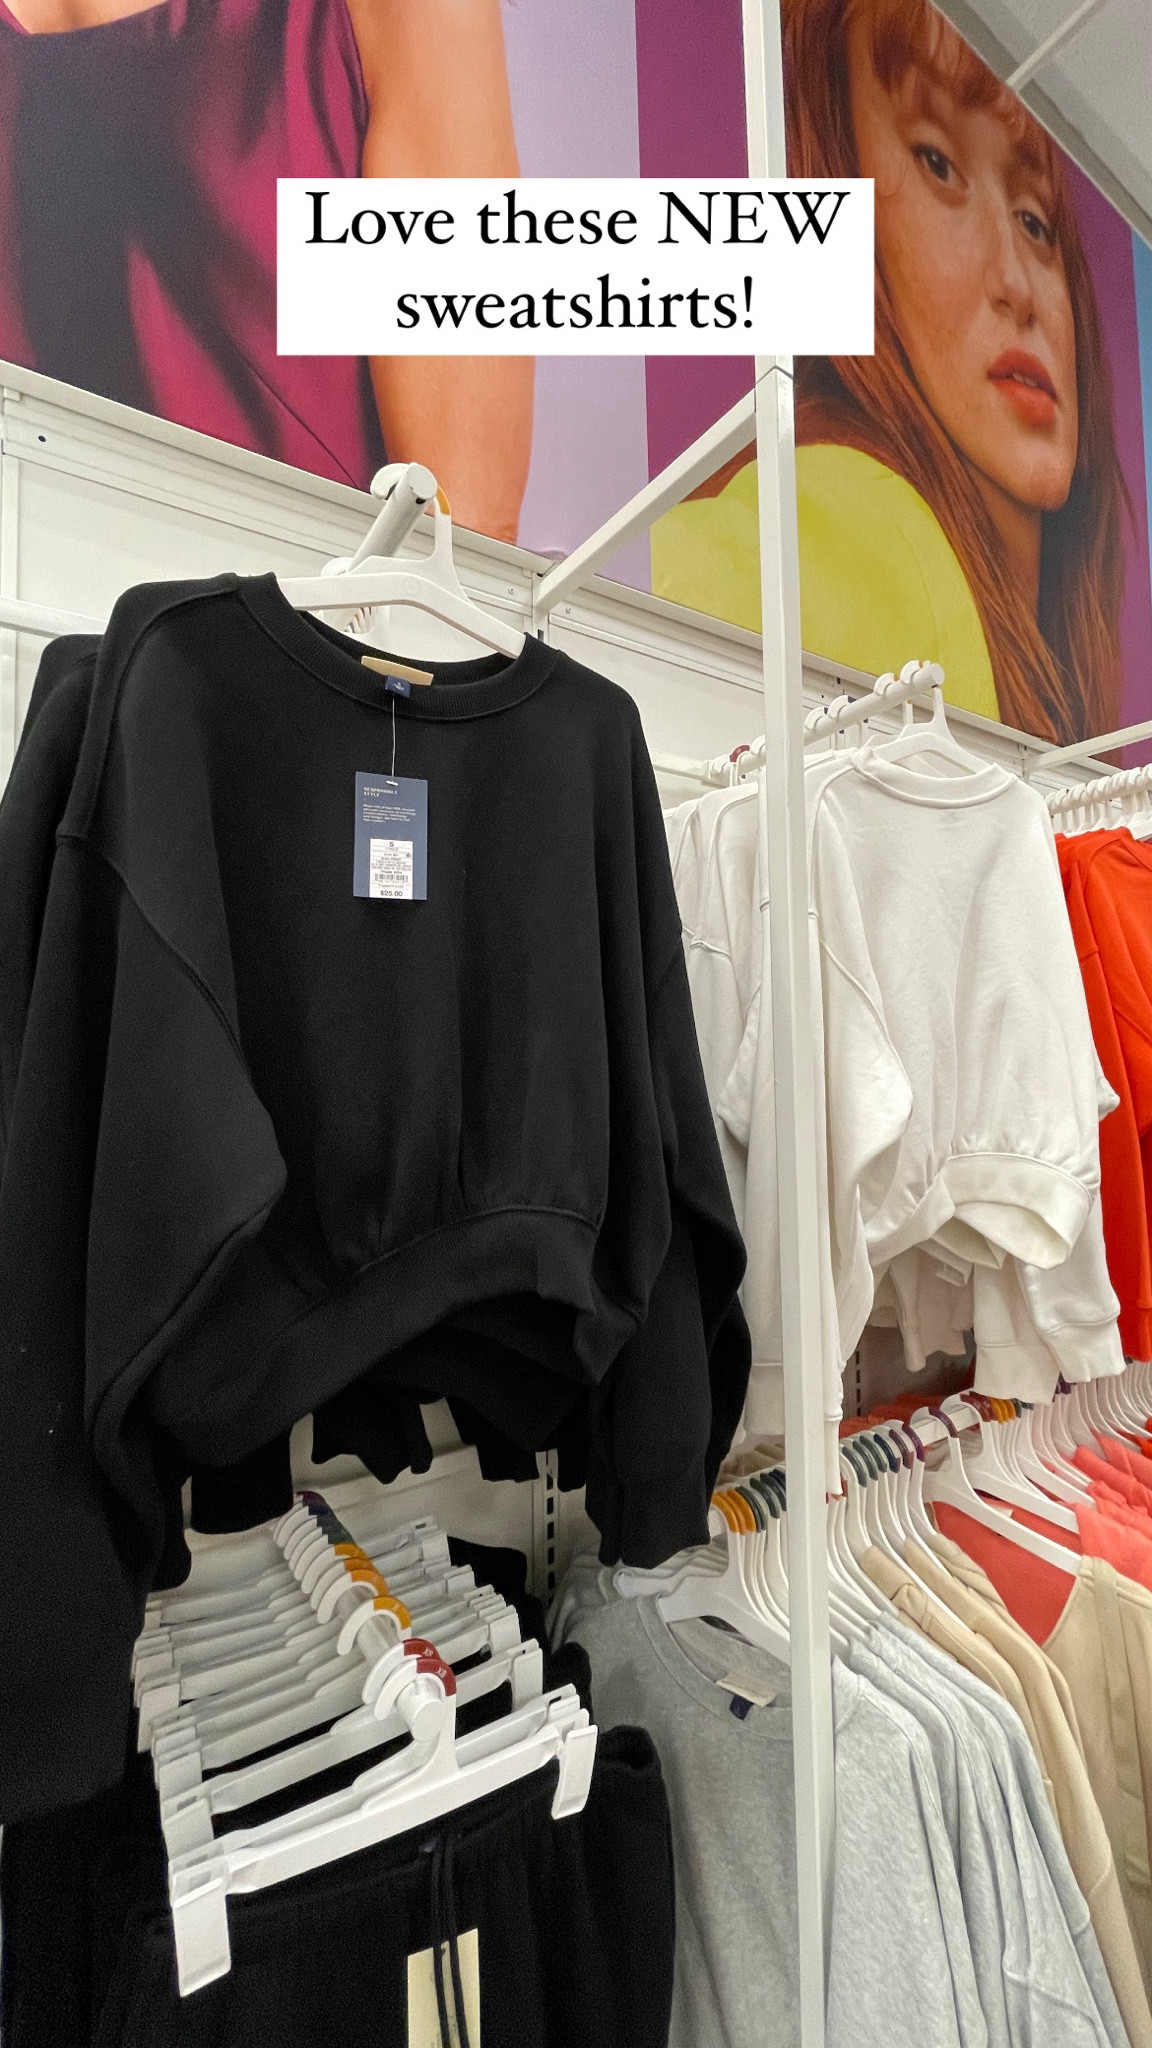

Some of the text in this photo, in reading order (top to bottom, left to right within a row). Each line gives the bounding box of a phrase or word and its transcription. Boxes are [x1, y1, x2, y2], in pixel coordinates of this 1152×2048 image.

[363, 787, 398, 795] RESPONSIBLE
[380, 889, 403, 897] $25.00
[436, 1667, 447, 1678] XS
